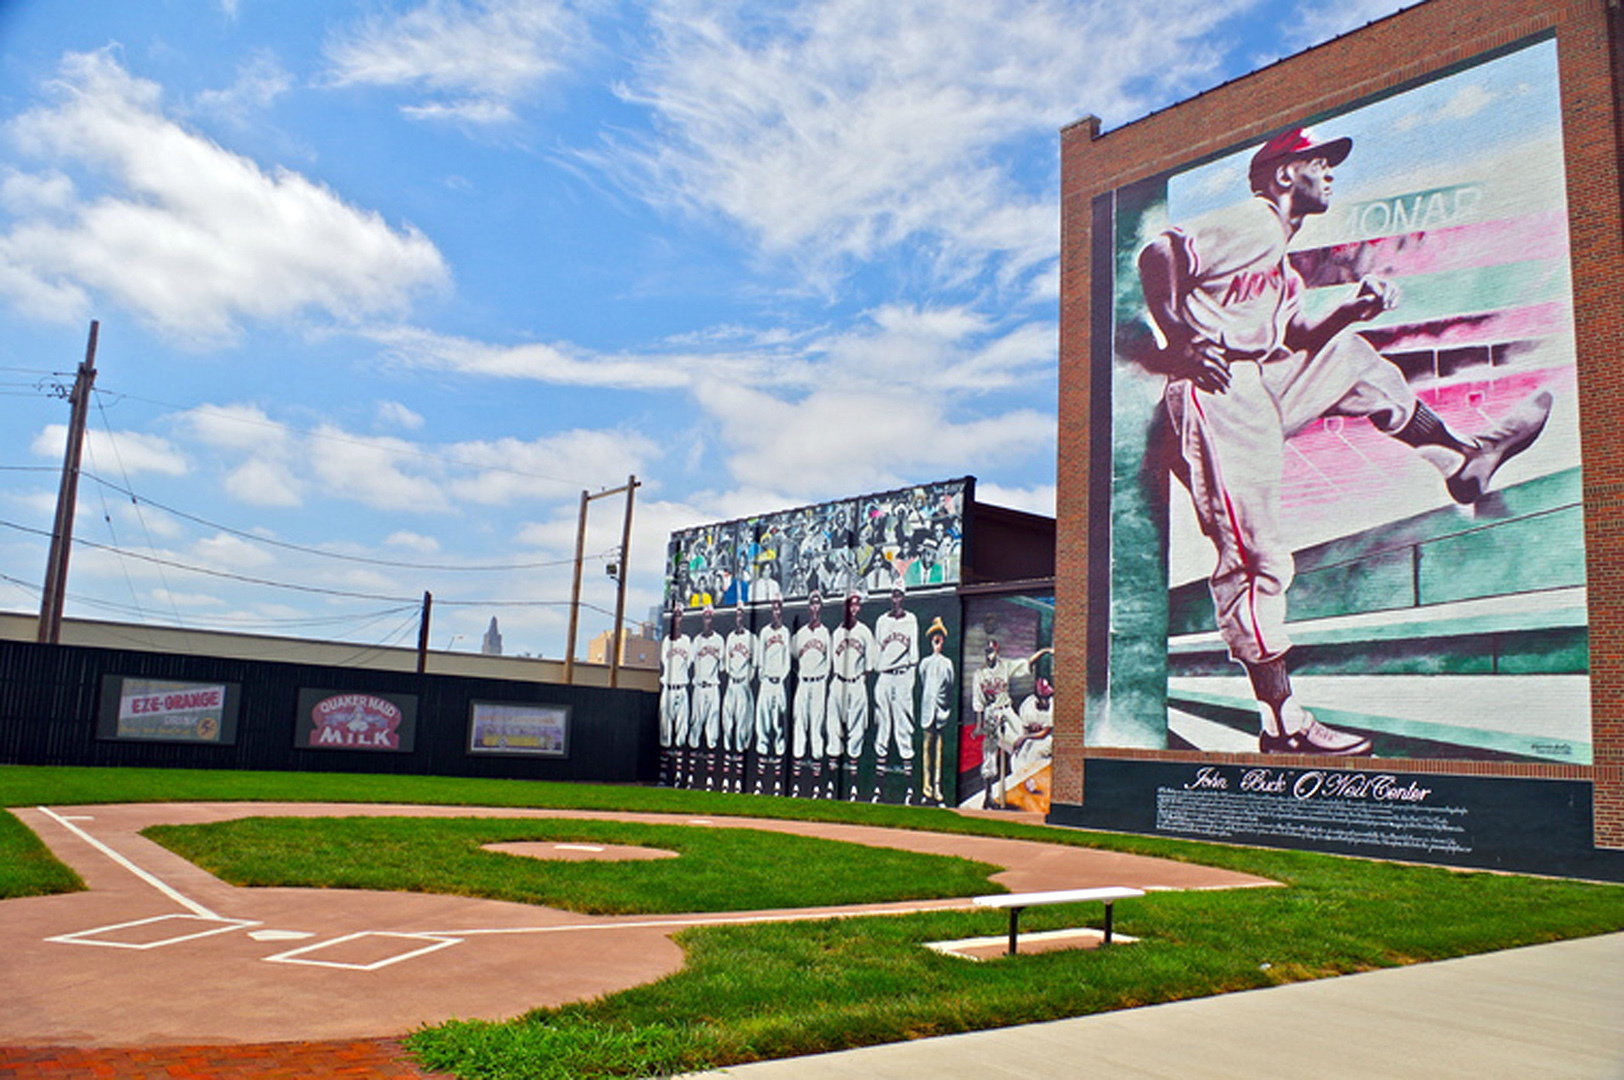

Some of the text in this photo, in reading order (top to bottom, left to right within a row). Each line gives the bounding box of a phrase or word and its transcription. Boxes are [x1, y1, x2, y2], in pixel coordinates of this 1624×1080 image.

[132, 691, 220, 714] EZE-ORANGE
[320, 695, 397, 717] QUAKER MAID
[318, 727, 391, 746] MILK
[1183, 766, 1228, 790] John
[1293, 770, 1371, 800] O'Neil
[1372, 774, 1432, 801] Center
